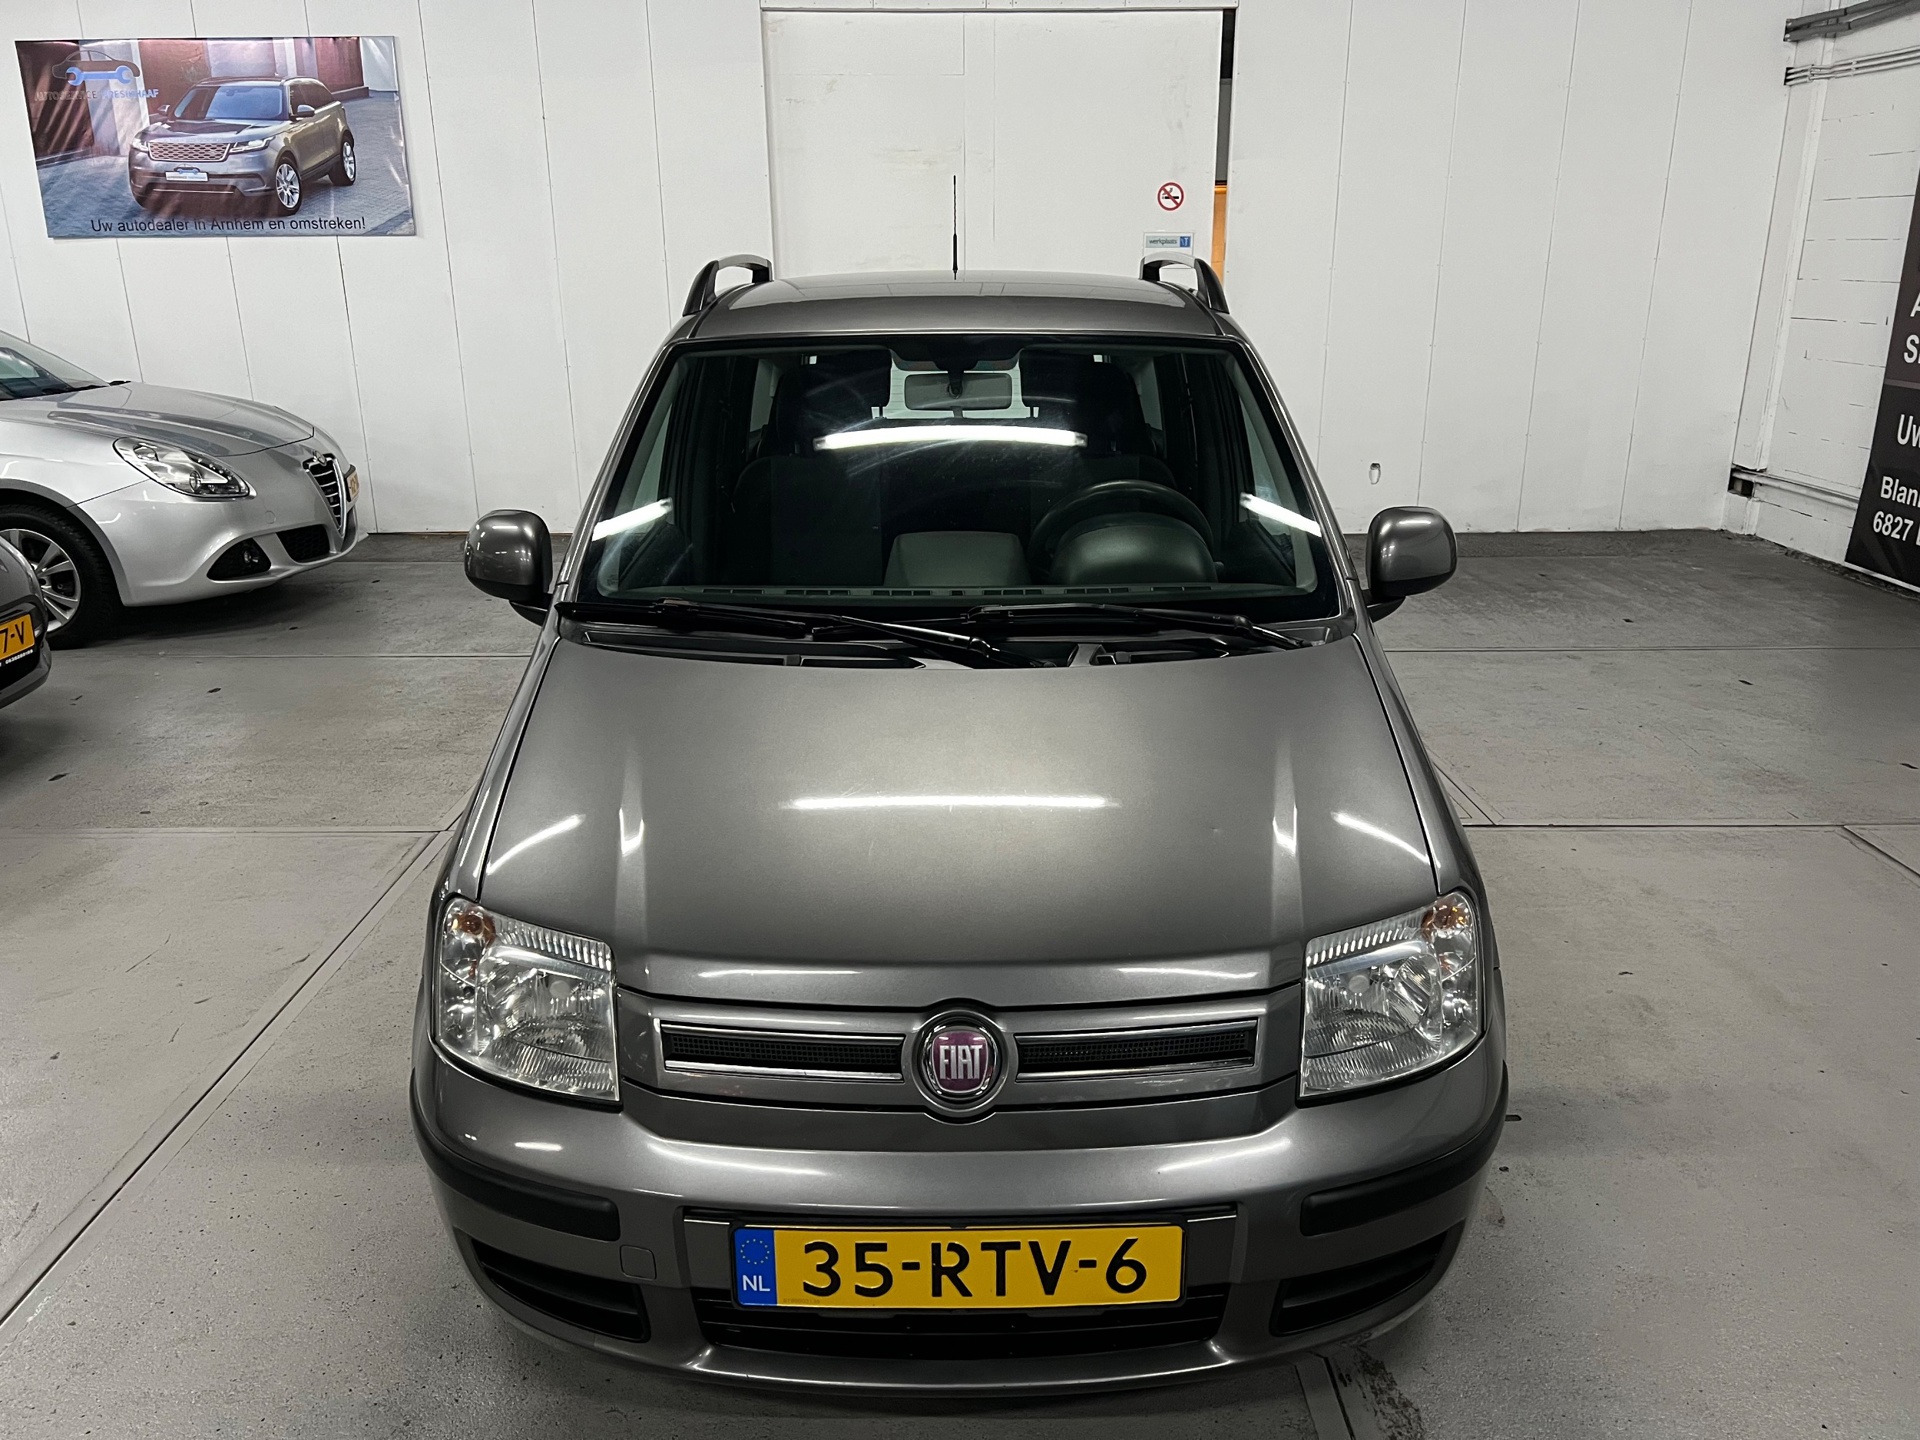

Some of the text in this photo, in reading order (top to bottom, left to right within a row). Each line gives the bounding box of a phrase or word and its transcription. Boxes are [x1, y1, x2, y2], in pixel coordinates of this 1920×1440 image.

[91, 217, 366, 233] Uw autodealer in Arnhem en omstreken!
[1149, 238, 1178, 246] werkplaats
[1880, 475, 1920, 508] Blan
[1872, 510, 1914, 542] 6827
[939, 1045, 983, 1080] FIAT
[742, 1238, 1148, 1298] NL 35-RTV-6
